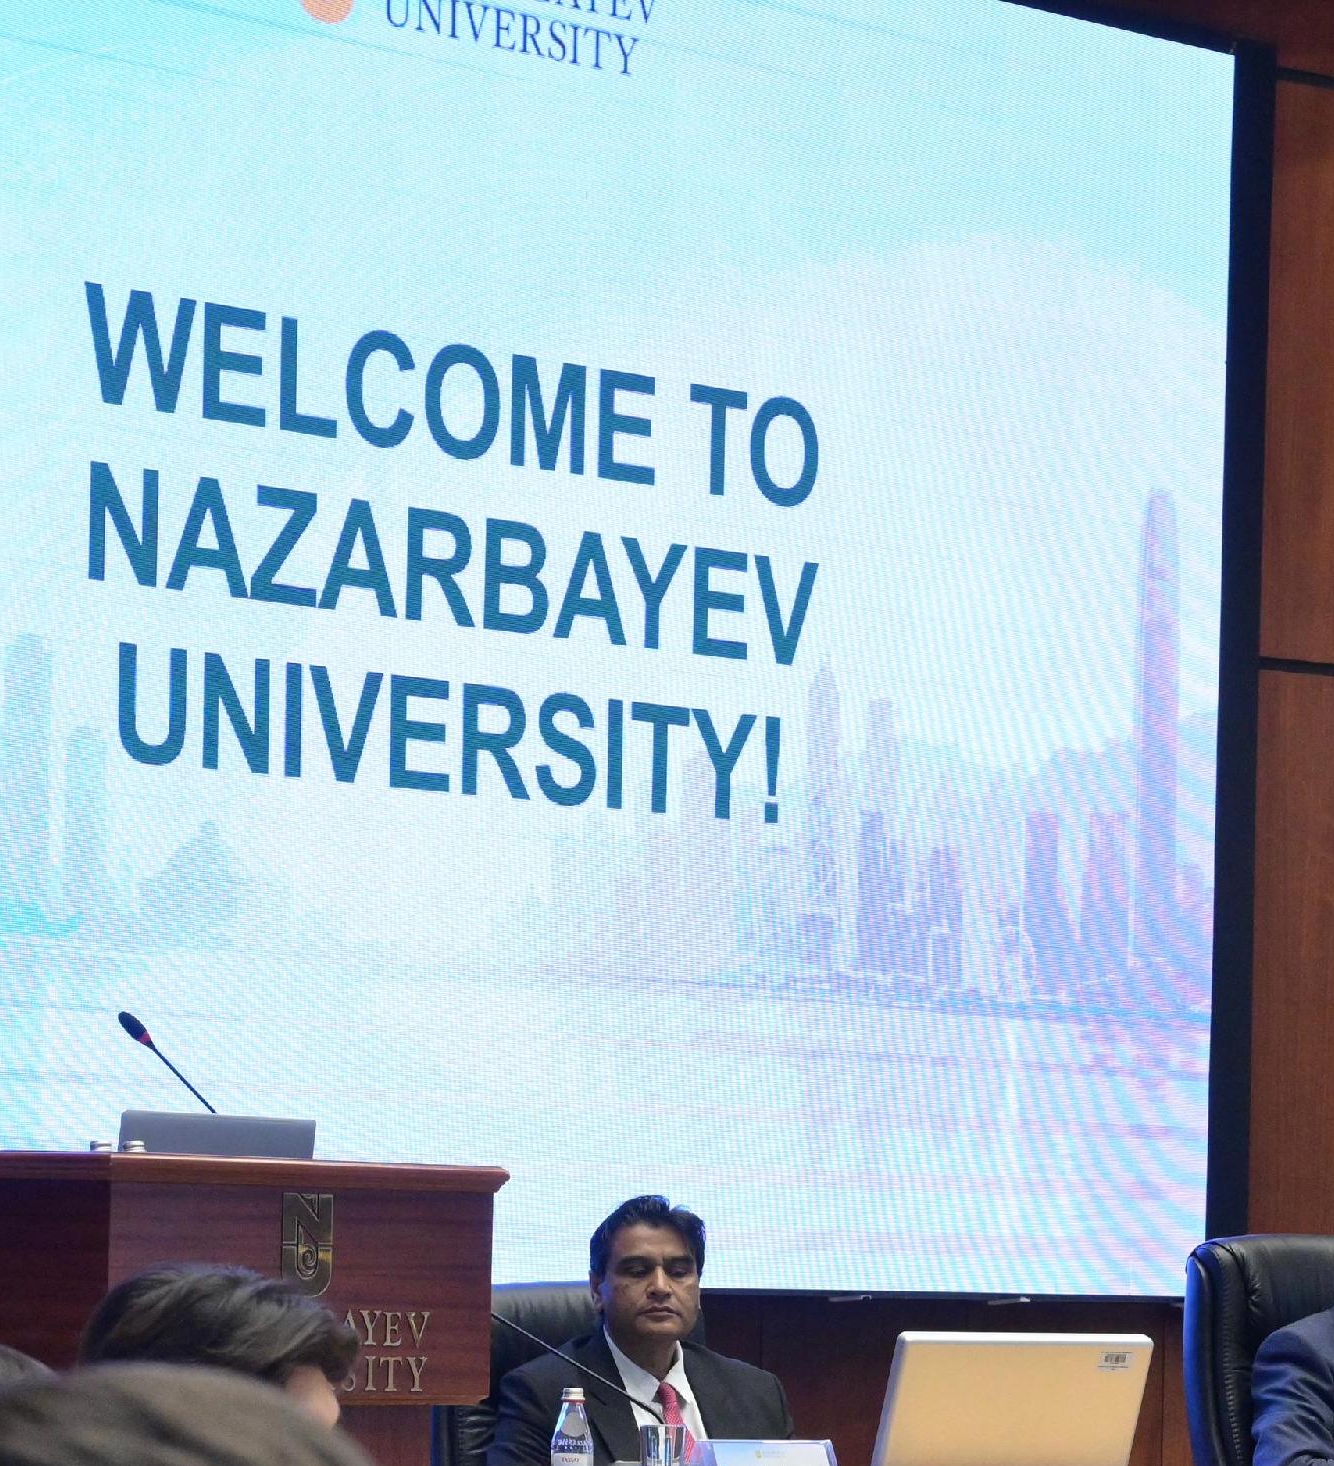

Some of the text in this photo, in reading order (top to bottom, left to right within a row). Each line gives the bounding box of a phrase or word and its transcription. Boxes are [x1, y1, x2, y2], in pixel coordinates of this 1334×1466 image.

[386, 0, 639, 75] UNIVERSITY
[84, 281, 819, 508] WELCOME TO
[88, 460, 819, 666] NAZARBAYEV
[118, 641, 782, 824] UNIVERSITY!
